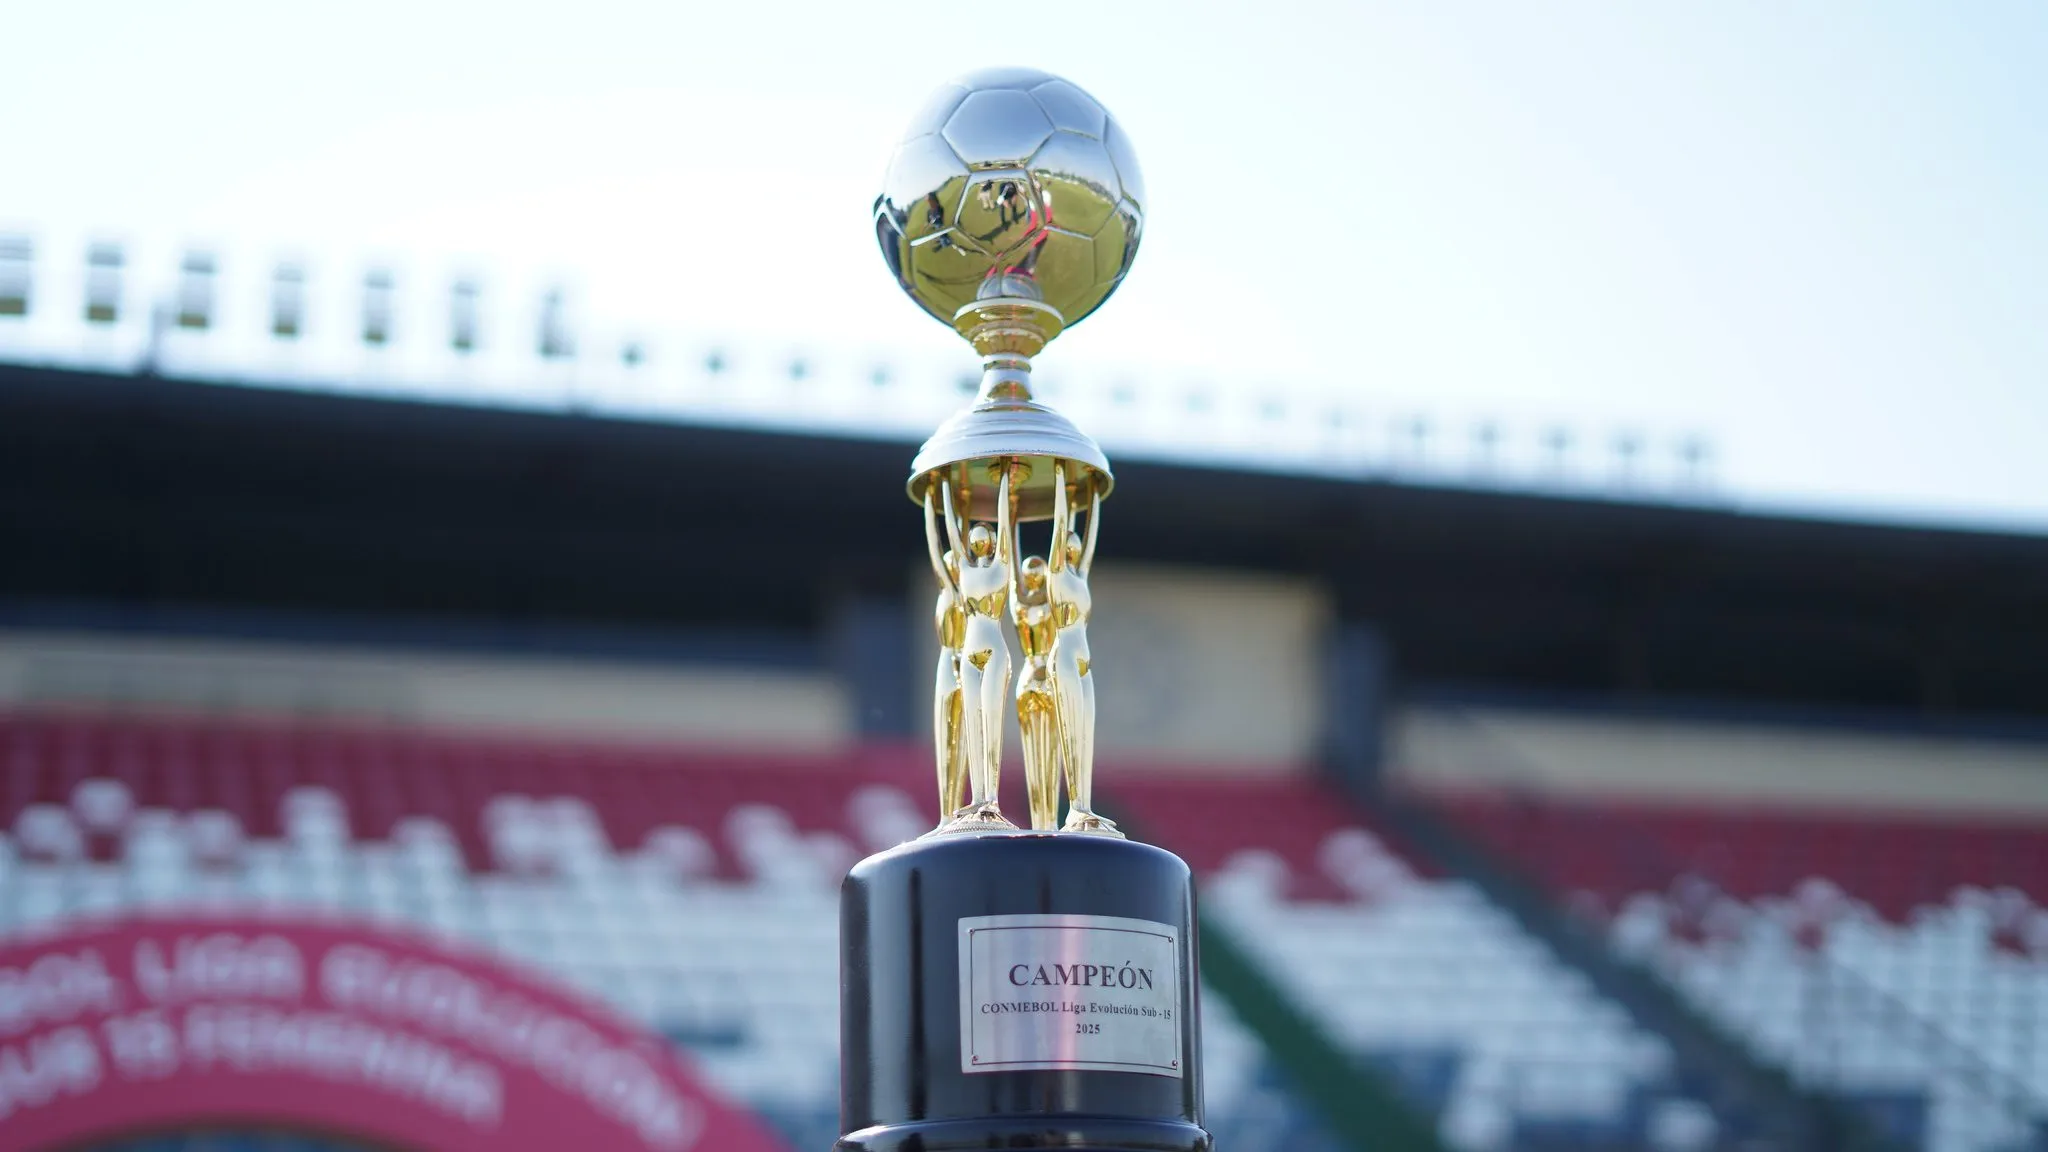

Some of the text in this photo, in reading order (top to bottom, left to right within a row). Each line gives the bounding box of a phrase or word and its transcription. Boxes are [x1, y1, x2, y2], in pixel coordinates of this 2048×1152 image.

[136, 936, 302, 1000] LIGA
[1008, 960, 1153, 991] CAMPEÓN
[981, 1001, 1059, 1014] CONMEBOL
[1062, 1001, 1087, 1015] Liga
[1090, 1002, 1139, 1016] Evolución
[1141, 1006, 1157, 1018] Sub
[1163, 1009, 1171, 1020] 15
[1076, 1023, 1101, 1034] 2025
